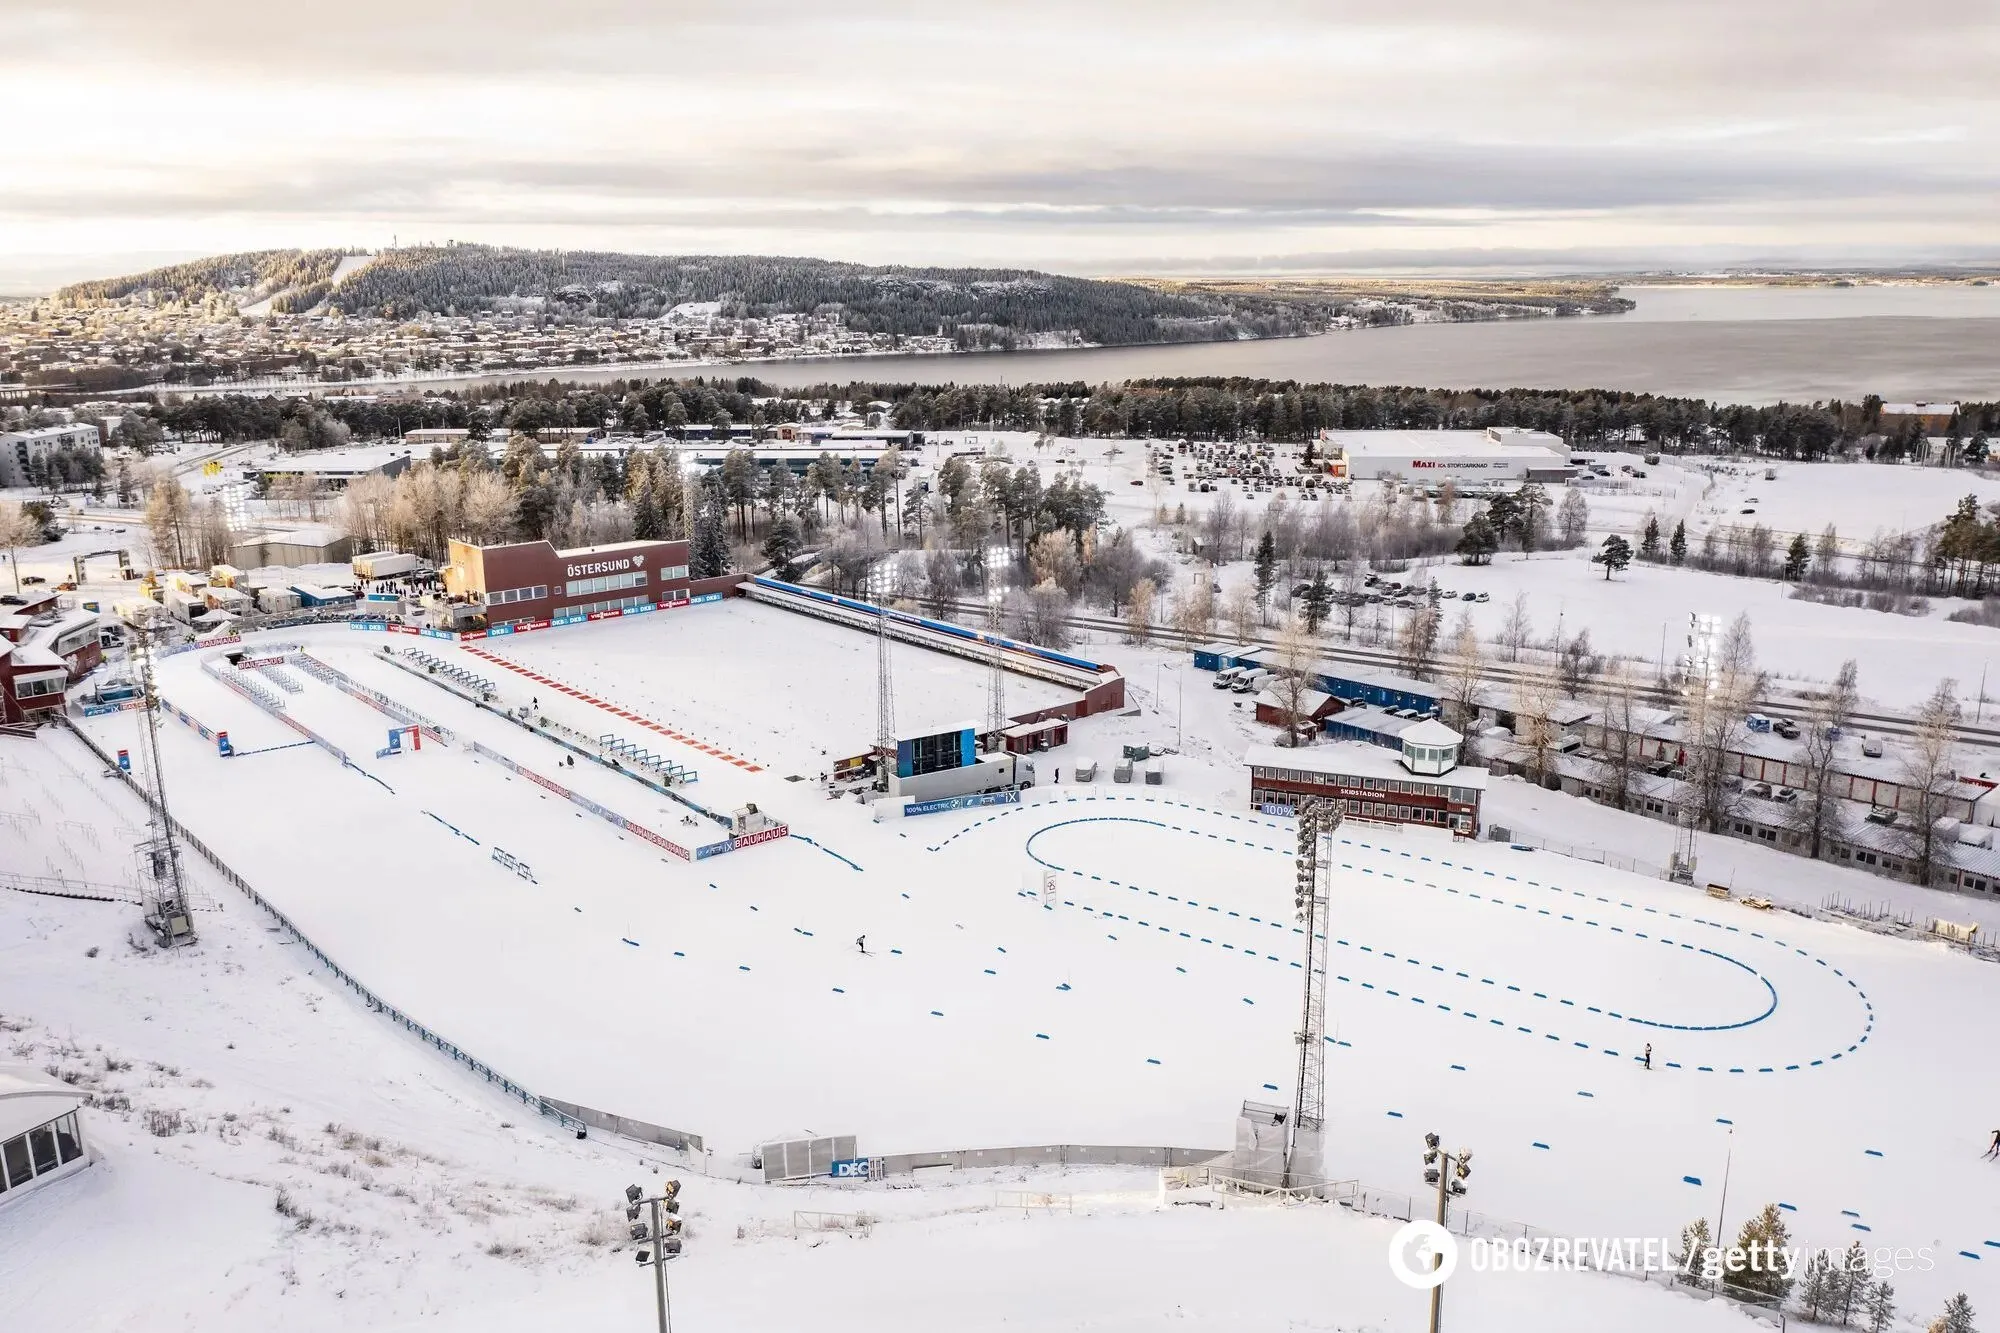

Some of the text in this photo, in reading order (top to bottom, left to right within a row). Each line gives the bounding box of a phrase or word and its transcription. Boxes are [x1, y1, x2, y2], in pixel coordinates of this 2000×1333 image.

[1412, 460, 1436, 468] MAXI
[567, 559, 630, 577] ÖSTERSUND
[199, 635, 241, 649] BAUHAUS
[238, 657, 283, 671] BAUUS
[1005, 791, 1017, 803] iX
[1340, 788, 1385, 799] SKIDSTADION
[905, 803, 950, 814] 100% ELECTRIC
[1265, 804, 1295, 817] 100%
[735, 826, 788, 848] BAUHAUS
